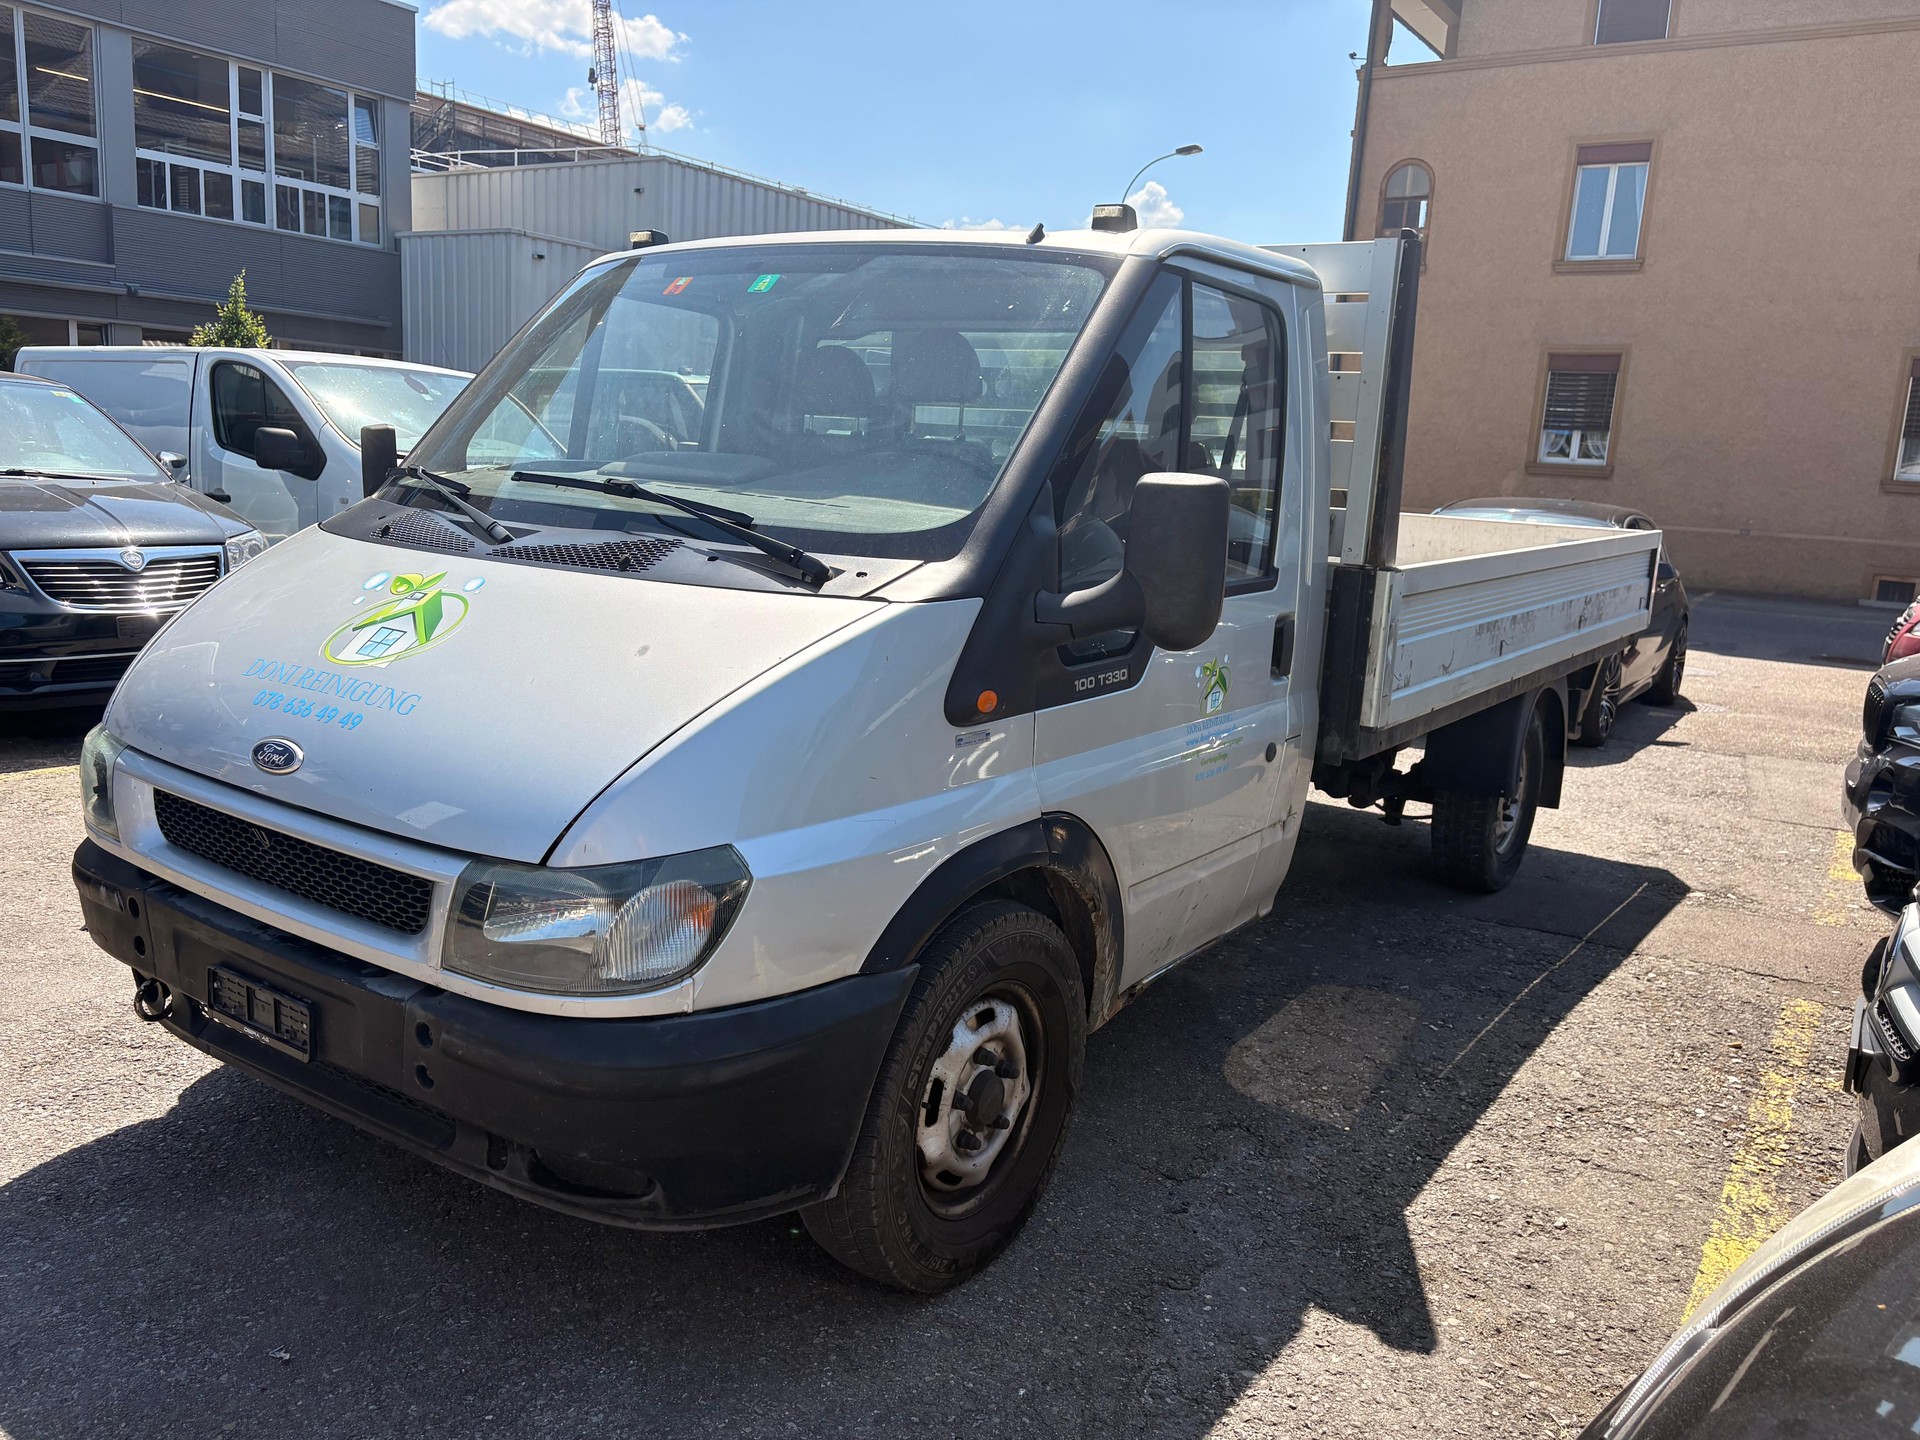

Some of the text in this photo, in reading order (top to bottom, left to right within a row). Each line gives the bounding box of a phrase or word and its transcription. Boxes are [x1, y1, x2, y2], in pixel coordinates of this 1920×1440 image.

[242, 657, 422, 716] DONI REINIGUNG
[1074, 668, 1128, 692] 100 T330
[252, 689, 365, 731] 078 636 49 49
[256, 743, 290, 766] Ford
[907, 974, 968, 1090] SEMPERIT
